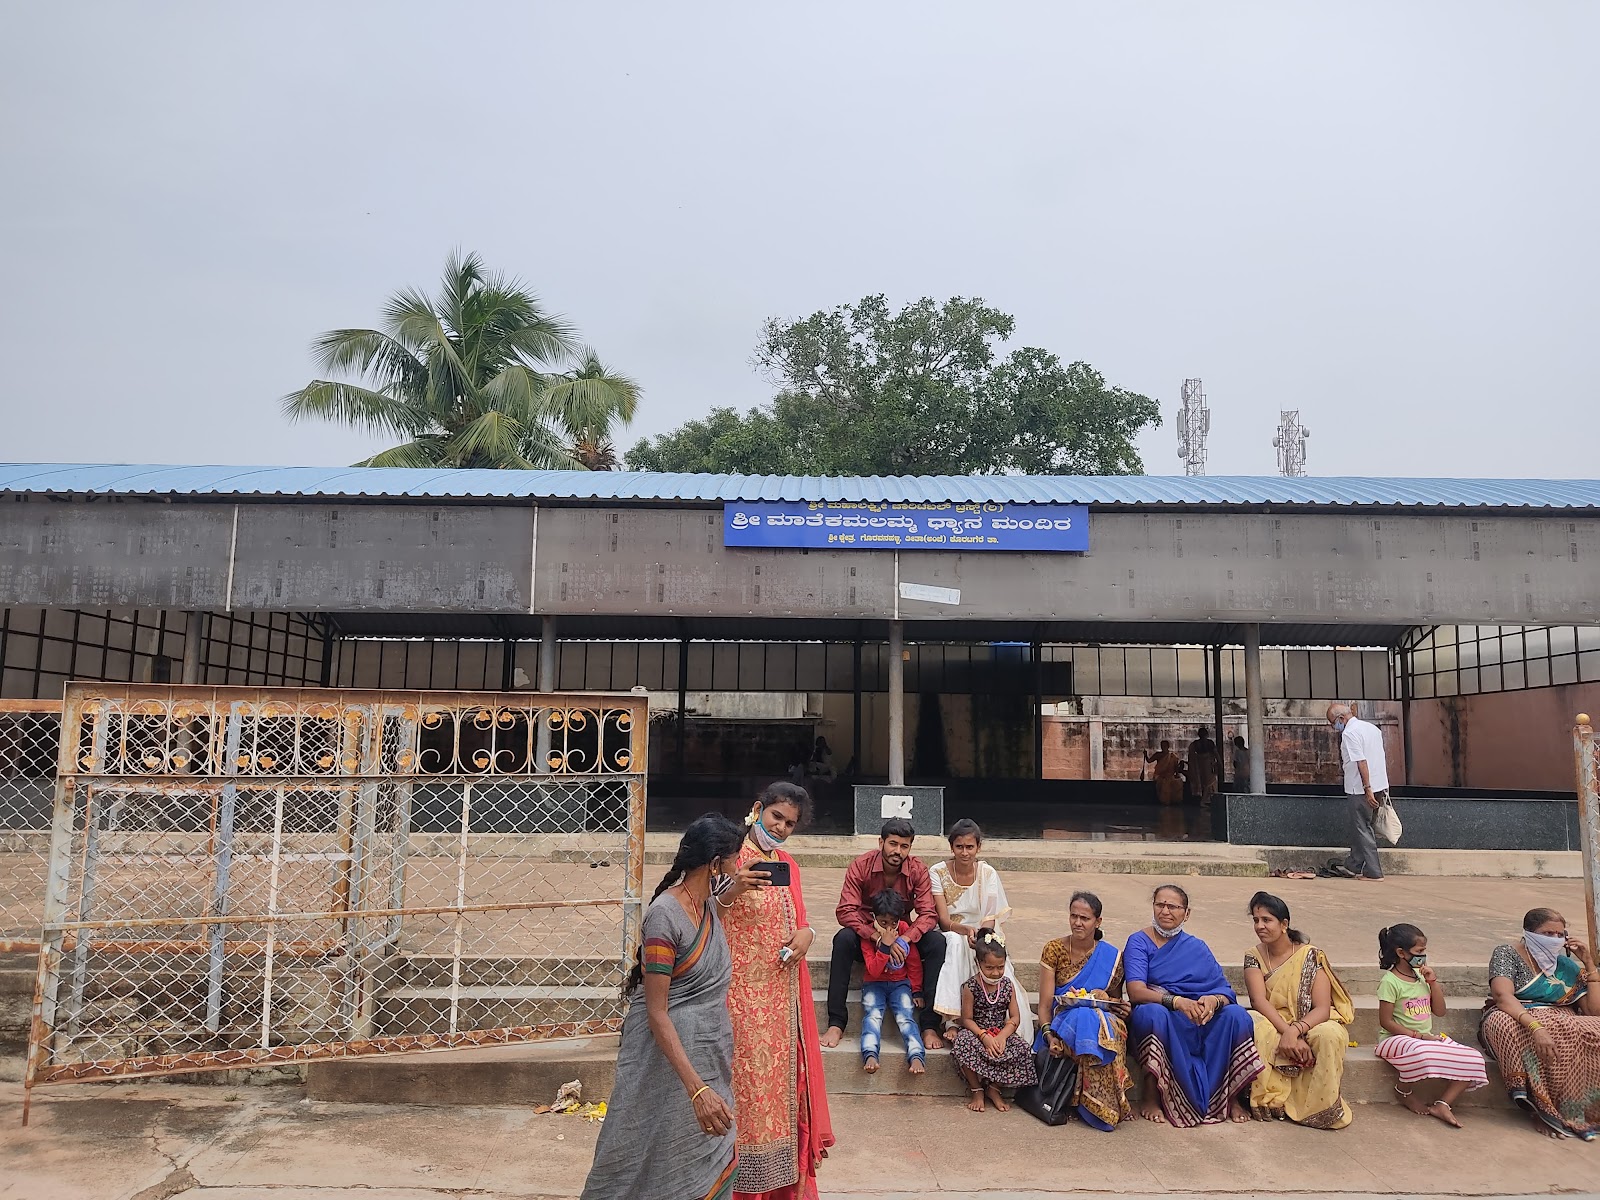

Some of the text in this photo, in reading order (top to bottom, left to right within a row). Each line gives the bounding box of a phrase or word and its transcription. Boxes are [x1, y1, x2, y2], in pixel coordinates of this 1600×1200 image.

[807, 502, 824, 511] ಶ್ರೀ
[730, 512, 1072, 534] ಶ್ರೀ ಮಾತೆಕಮಲಮ್ಮ ಧ್ಯಾನ ಮಂದಿರ
